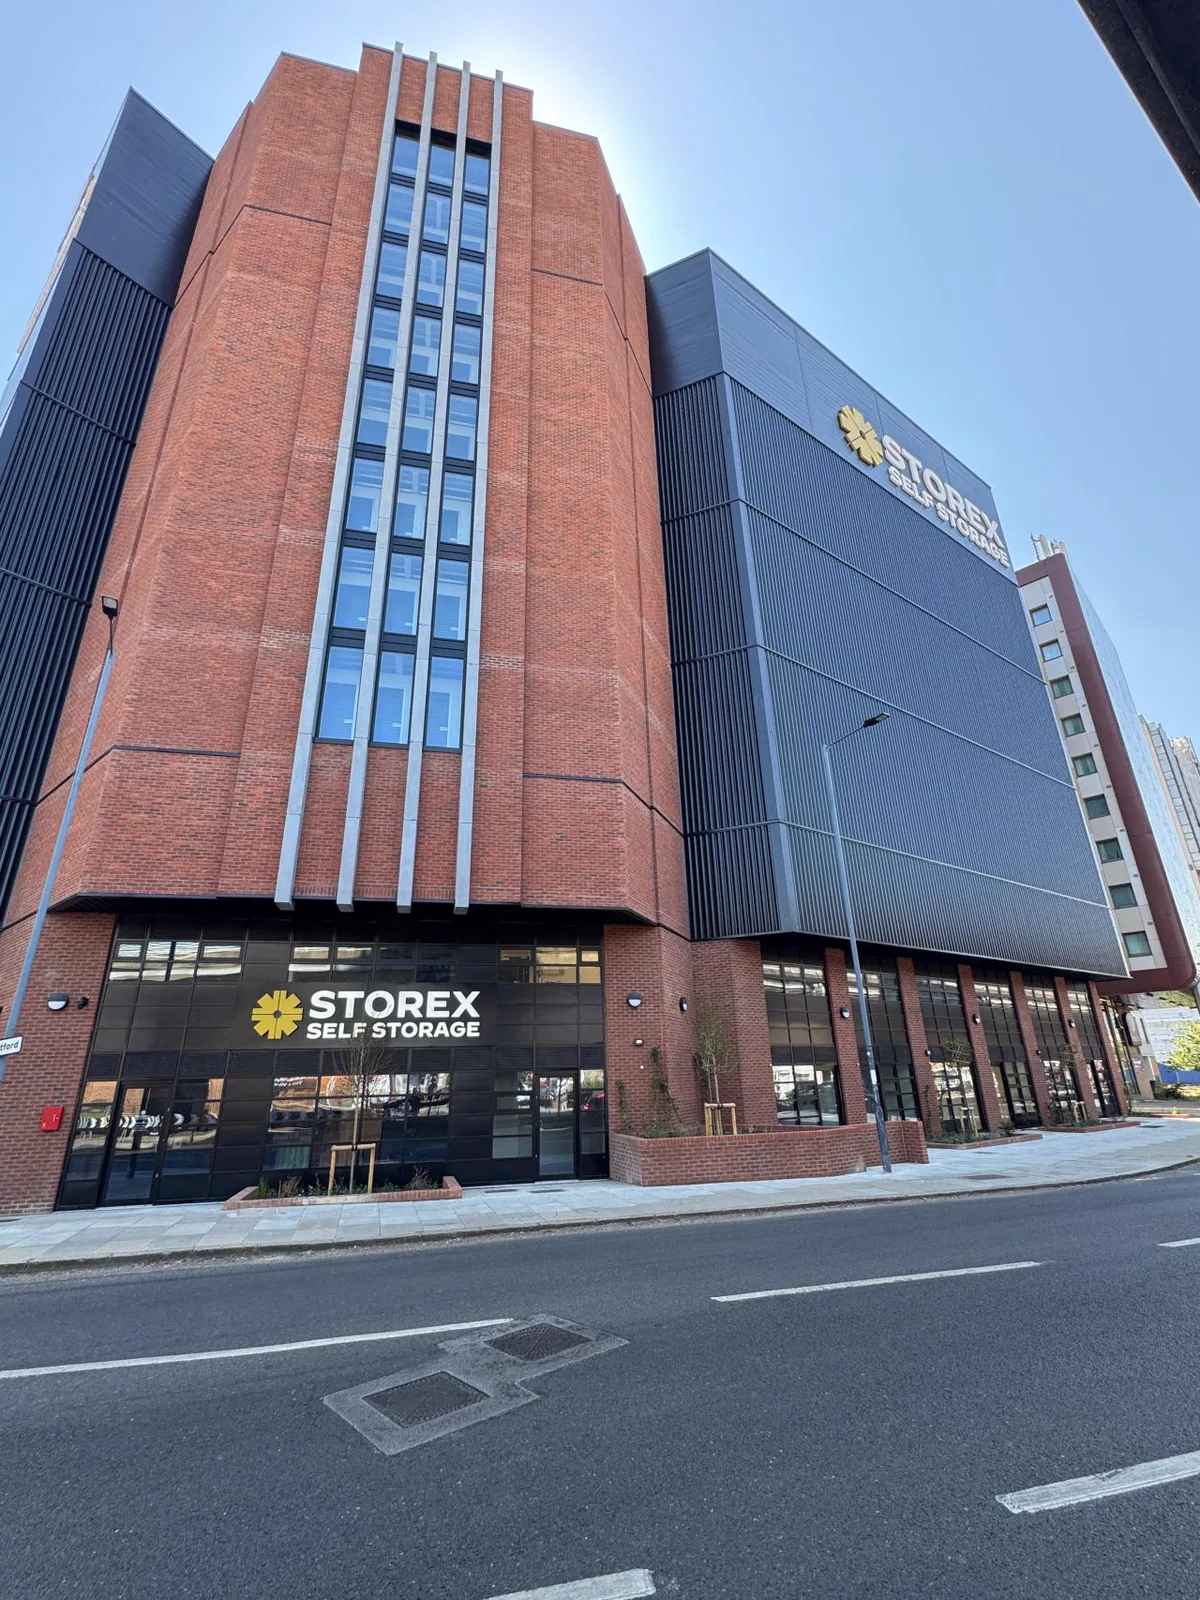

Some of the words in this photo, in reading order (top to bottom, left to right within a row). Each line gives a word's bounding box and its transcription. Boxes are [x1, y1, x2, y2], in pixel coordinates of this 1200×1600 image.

[882, 435, 1005, 549] STOREX
[887, 465, 933, 508] SELF
[935, 502, 1010, 568] STORAGE
[306, 1022, 367, 1039] SELF
[371, 1021, 481, 1038] STORAGE
[308, 989, 481, 1019] STOREX
